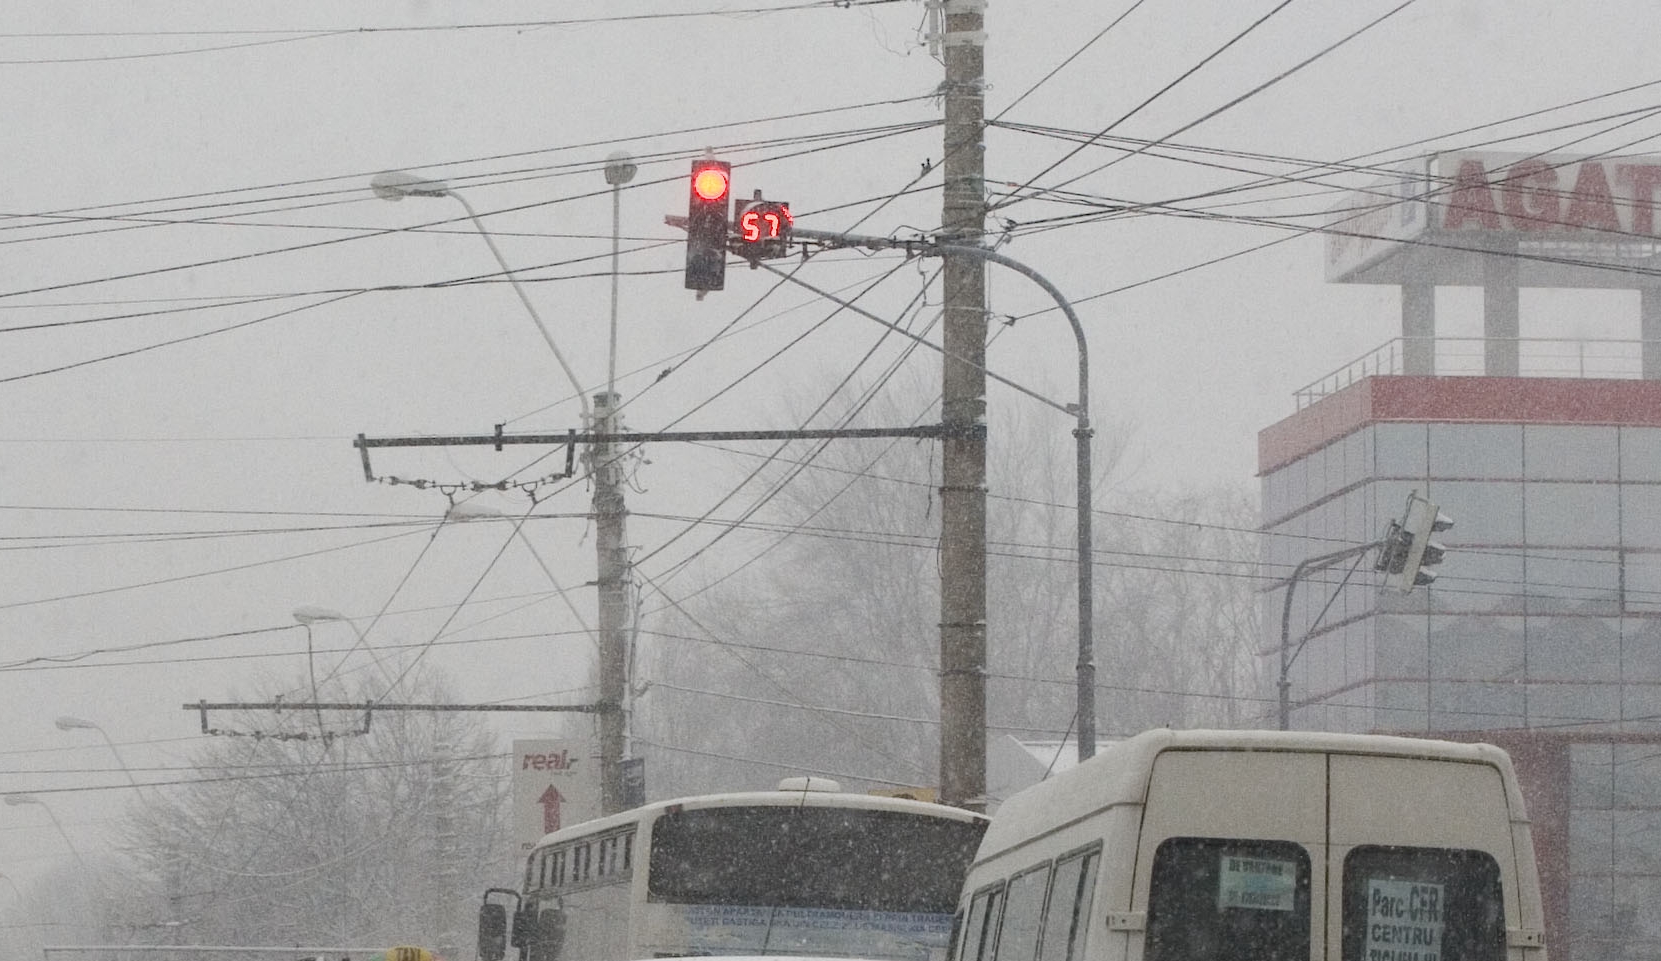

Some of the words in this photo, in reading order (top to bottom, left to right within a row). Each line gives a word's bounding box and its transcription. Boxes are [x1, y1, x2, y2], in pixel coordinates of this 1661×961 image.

[741, 211, 780, 242] 57
[1371, 888, 1404, 918] Parc
[1371, 924, 1434, 946] CENTRU
